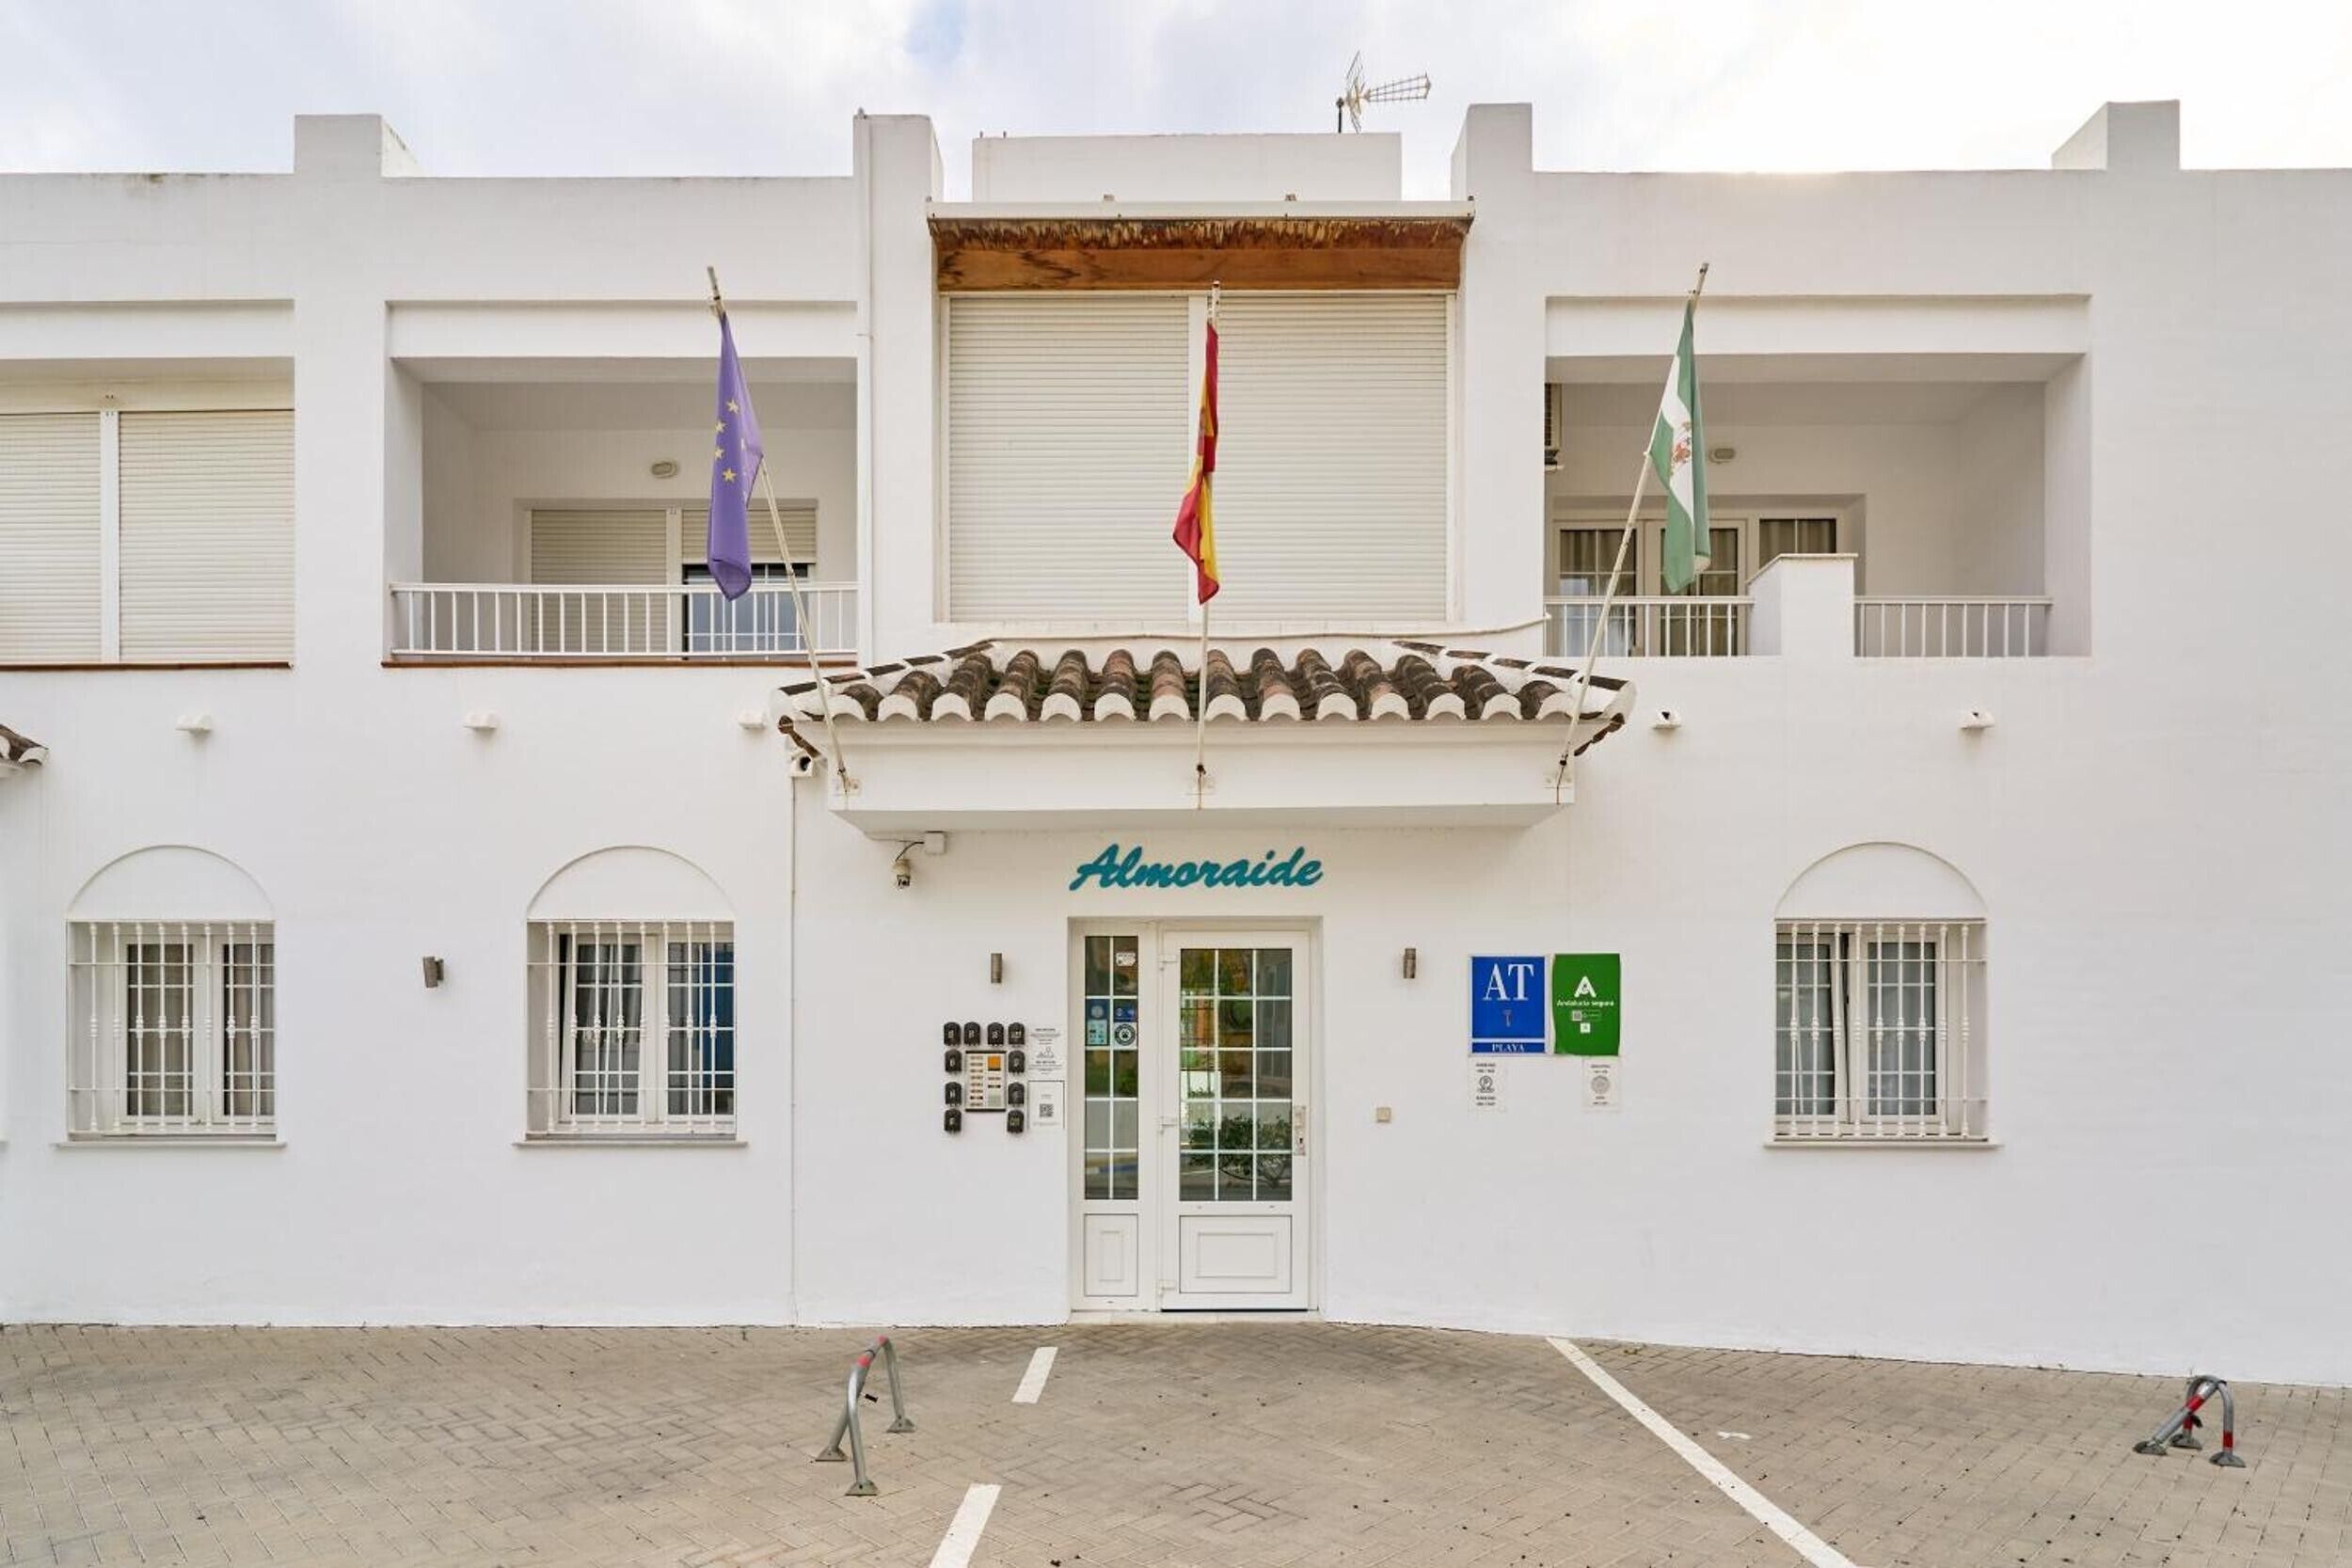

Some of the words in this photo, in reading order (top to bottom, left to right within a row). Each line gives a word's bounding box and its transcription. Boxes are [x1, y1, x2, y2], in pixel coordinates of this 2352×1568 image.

[1069, 843, 1324, 891] Almoraide
[1483, 962, 1534, 1002] AT
[1491, 1043, 1525, 1053] PLAYA
